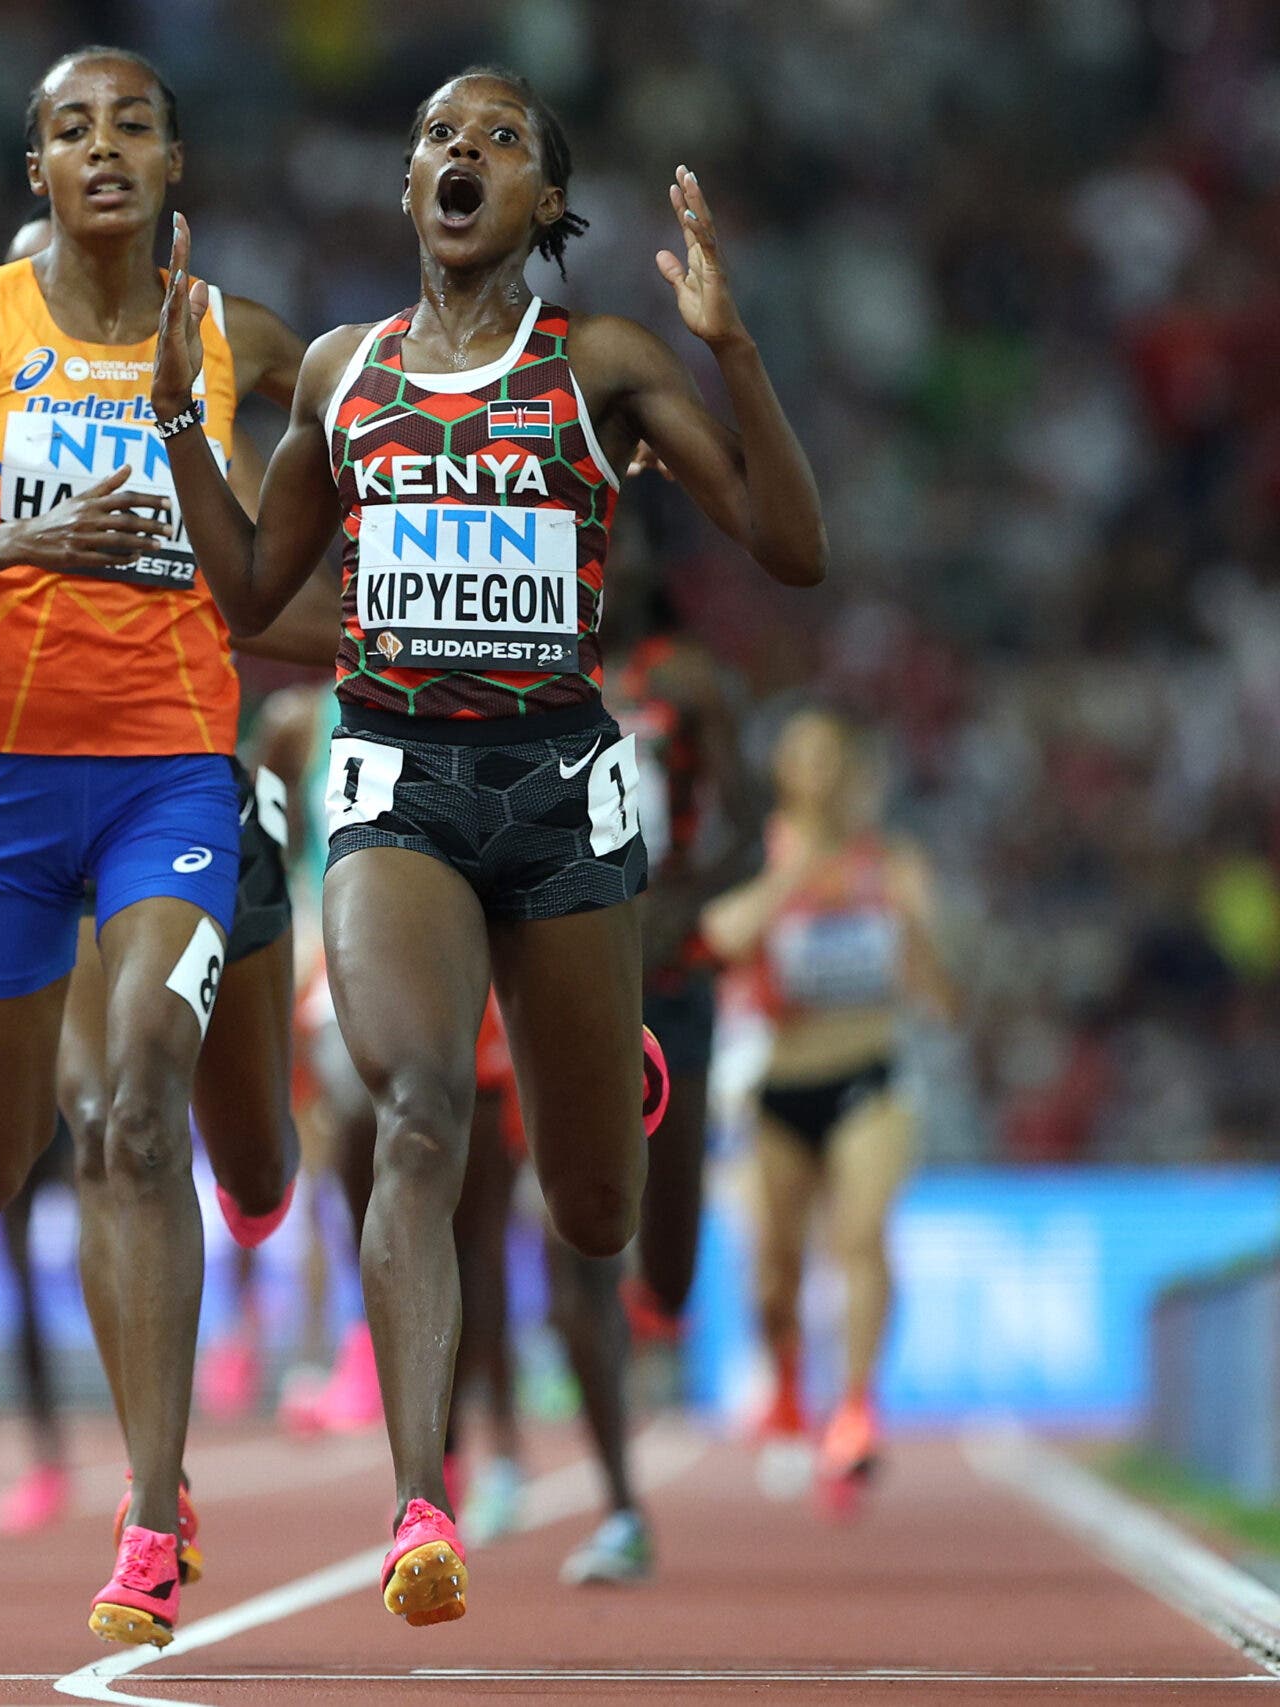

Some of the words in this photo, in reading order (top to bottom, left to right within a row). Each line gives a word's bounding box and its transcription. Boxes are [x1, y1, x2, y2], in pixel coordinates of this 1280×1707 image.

[26, 395, 205, 422] nederla
[158, 410, 194, 438] LYN
[353, 454, 549, 499] KENYA
[393, 508, 536, 564] NTN
[367, 572, 564, 624] KIPYEGON
[609, 761, 627, 831] 1
[200, 954, 220, 1014] 8
